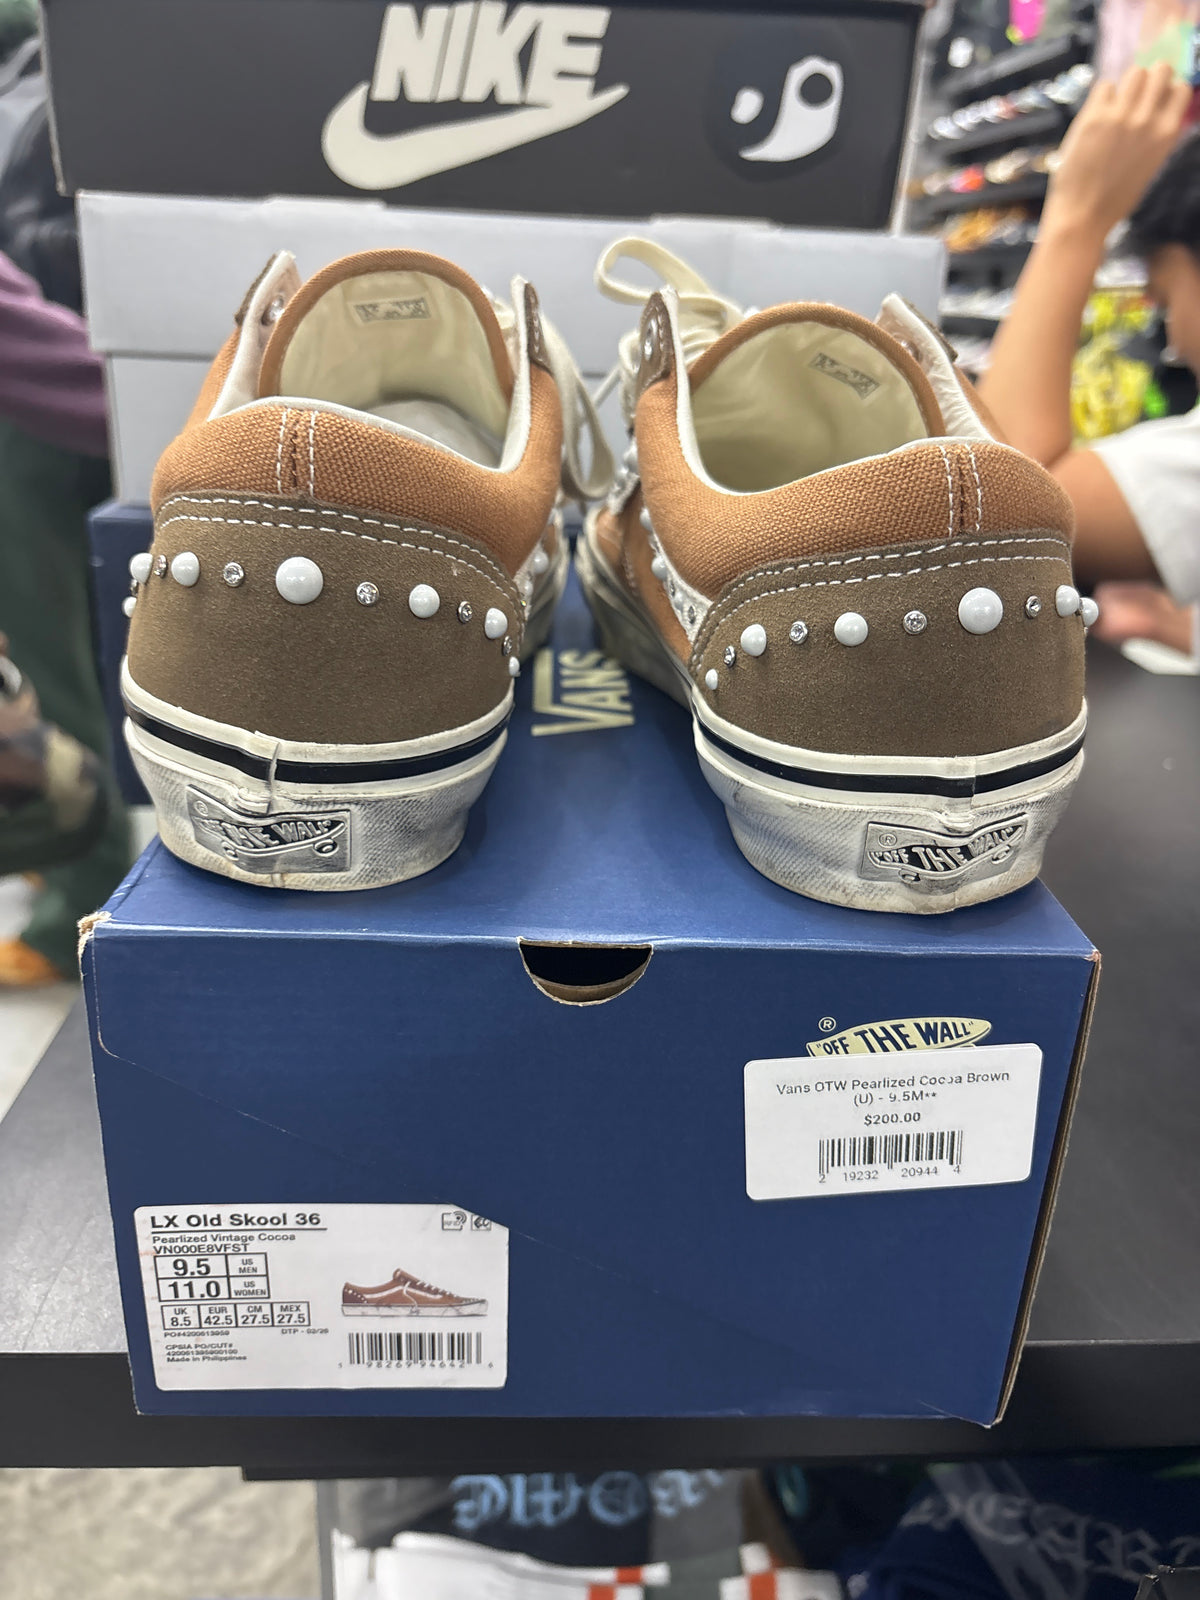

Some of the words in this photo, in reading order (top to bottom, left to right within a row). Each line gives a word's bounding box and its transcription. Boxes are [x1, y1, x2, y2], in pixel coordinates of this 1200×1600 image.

[370, 3, 611, 105] NIKE
[531, 648, 635, 736] VANS
[912, 846, 968, 872] THE
[853, 1023, 917, 1053] THE
[776, 1084, 811, 1095] Vans
[814, 1080, 847, 1093] OTW
[851, 1076, 915, 1090] Pearlized
[967, 1072, 1010, 1083] Brown
[853, 1092, 874, 1107] (U)
[864, 1112, 921, 1126] $200.00
[843, 1169, 879, 1182] 19232
[901, 1166, 938, 1178] 20944
[150, 1214, 179, 1228] LX
[186, 1213, 222, 1227] Old
[229, 1212, 287, 1226] Skool
[295, 1212, 321, 1226] 36
[152, 1234, 207, 1244] Pearlized
[211, 1233, 255, 1243] Vintage
[258, 1232, 296, 1242] Cocoa
[153, 1243, 250, 1255] VN000E8VFST
[172, 1257, 211, 1277] 9.5
[241, 1258, 253, 1266] US
[238, 1266, 258, 1274] MEN
[168, 1280, 220, 1299] 11.0
[234, 1289, 267, 1297] WOMEN
[174, 1307, 187, 1315] UK
[208, 1306, 228, 1314] EUR
[247, 1305, 263, 1313] CM
[280, 1304, 301, 1312] MEX
[170, 1316, 192, 1327] 8.5
[204, 1315, 233, 1326] 42.5
[241, 1314, 270, 1325] 27.5
[277, 1313, 306, 1324] 27.5
